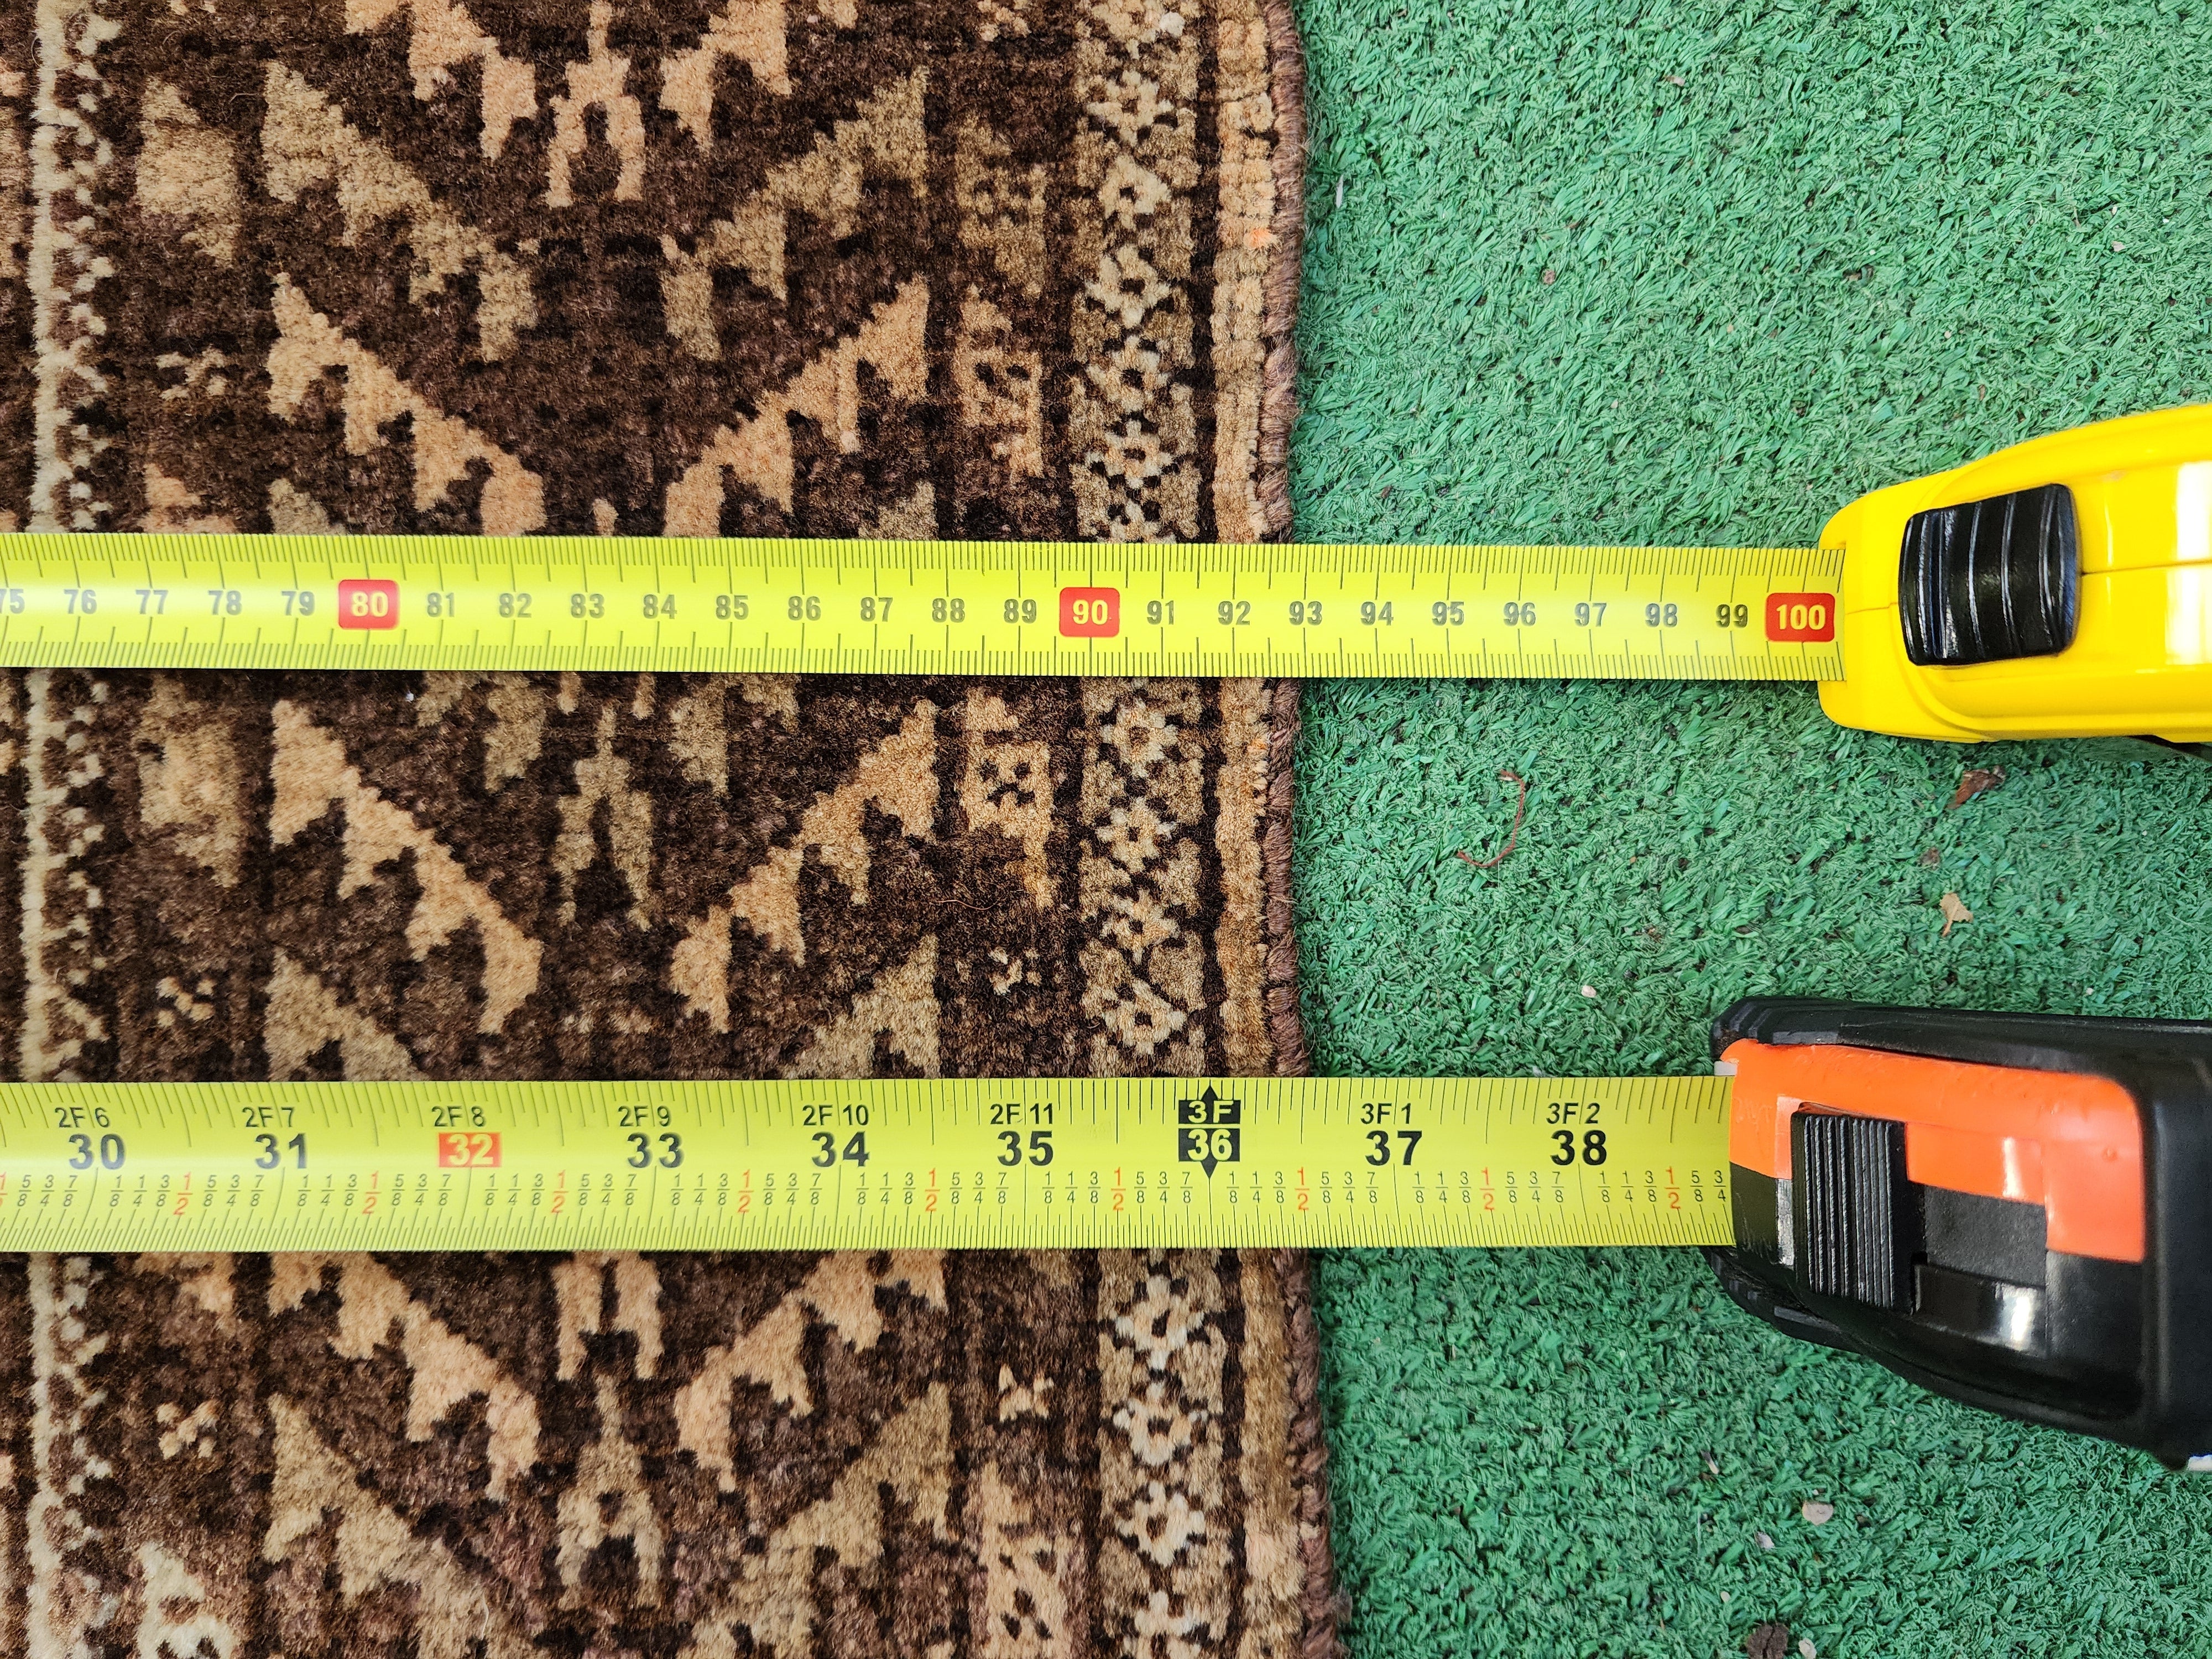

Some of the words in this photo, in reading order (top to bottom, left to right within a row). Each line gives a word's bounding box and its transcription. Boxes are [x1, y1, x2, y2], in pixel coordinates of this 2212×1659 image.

[0, 589, 25, 614] 75
[64, 589, 96, 614] 76
[135, 590, 168, 615] 77
[208, 590, 242, 615] 78
[281, 591, 315, 617] 79
[351, 592, 389, 618] 80
[426, 592, 455, 618] 81
[499, 593, 532, 618] 82
[570, 594, 605, 619] 83
[643, 594, 677, 620] 84
[716, 595, 749, 620] 85
[787, 596, 821, 622] 86
[860, 597, 894, 623] 87
[931, 598, 966, 623] 88
[1003, 598, 1036, 624] 89
[1072, 599, 1108, 625] 90
[1146, 600, 1175, 625] 91
[1218, 601, 1251, 626] 92
[1289, 601, 1322, 626] 93
[1360, 601, 1394, 627] 94
[1432, 601, 1464, 627] 95
[1504, 602, 1536, 627] 96
[1574, 602, 1608, 628] 97
[1645, 603, 1678, 628] 98
[1716, 604, 1749, 628] 99
[1776, 605, 1825, 630] 100
[69, 1134, 127, 1170] 30
[254, 1133, 307, 1169] 31
[448, 1134, 494, 1166] 32
[627, 1133, 684, 1167] 33
[811, 1131, 870, 1167] 34
[997, 1131, 1053, 1166] 35
[1187, 1129, 1233, 1161] 36
[1366, 1130, 1422, 1166] 37
[1551, 1130, 1606, 1165] 38
